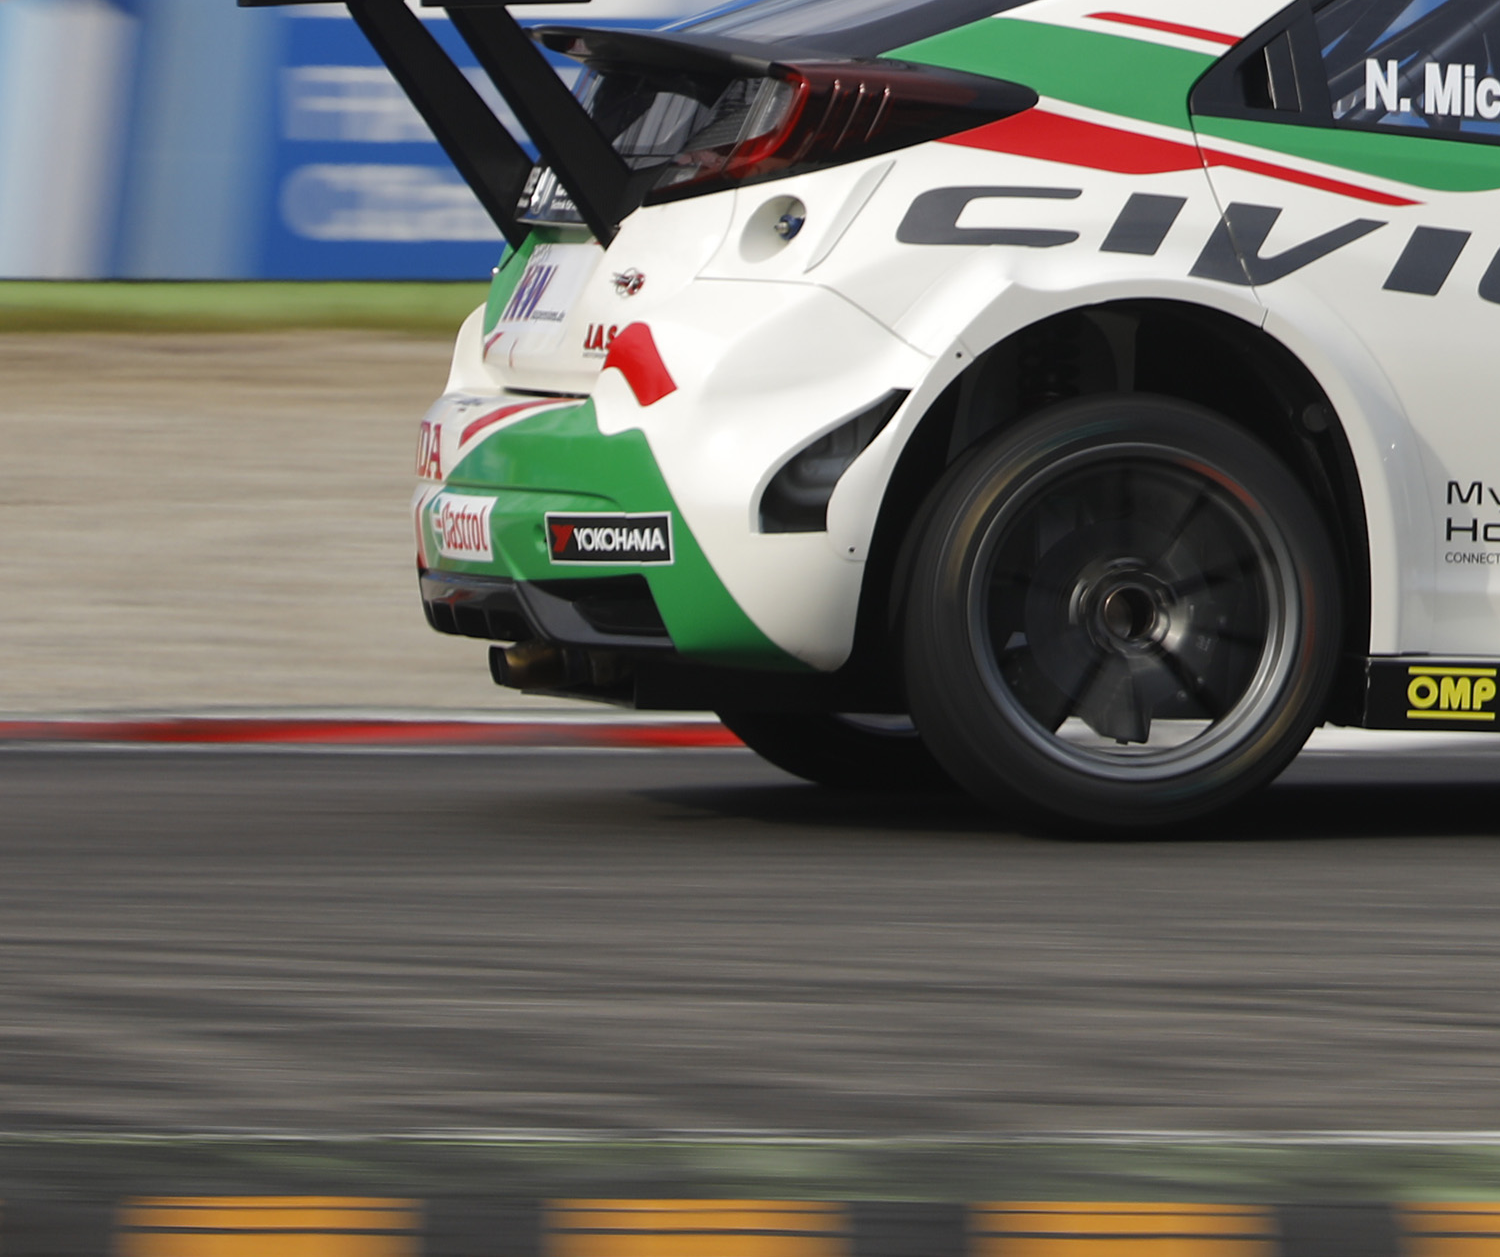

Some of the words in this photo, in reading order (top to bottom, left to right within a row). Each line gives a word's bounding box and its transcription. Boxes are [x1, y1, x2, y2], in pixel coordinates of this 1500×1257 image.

[1365, 59, 1411, 112] N.
[443, 501, 488, 552] Castrol
[573, 527, 666, 551] YOKOHAMA
[1407, 676, 1496, 710] OMP
